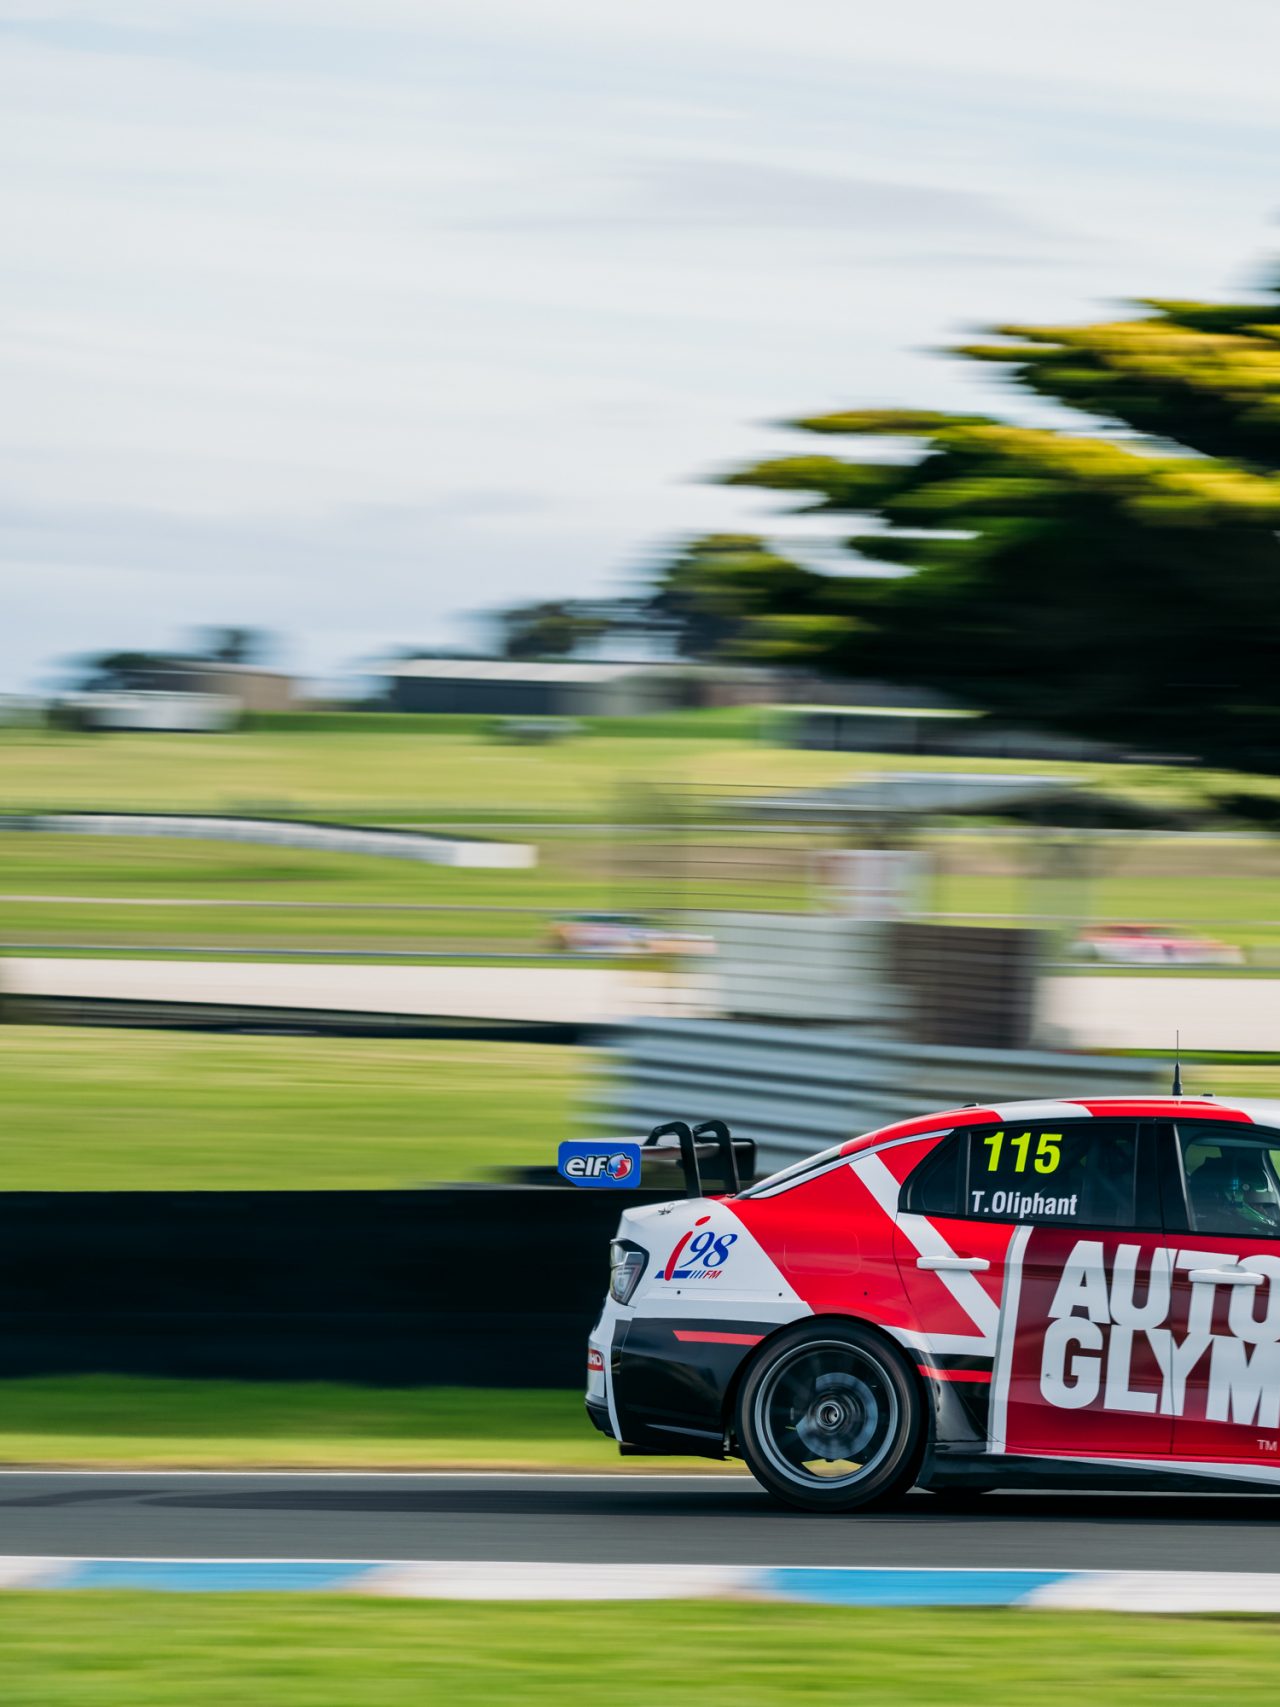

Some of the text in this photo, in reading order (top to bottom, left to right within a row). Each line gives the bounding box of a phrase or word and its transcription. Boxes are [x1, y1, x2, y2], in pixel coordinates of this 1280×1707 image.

[984, 1132, 1063, 1174] 115
[566, 1156, 608, 1176] elf
[971, 1190, 1078, 1219] T.Oliphant
[703, 1270, 722, 1279] FM
[1256, 1439, 1278, 1452] TM
